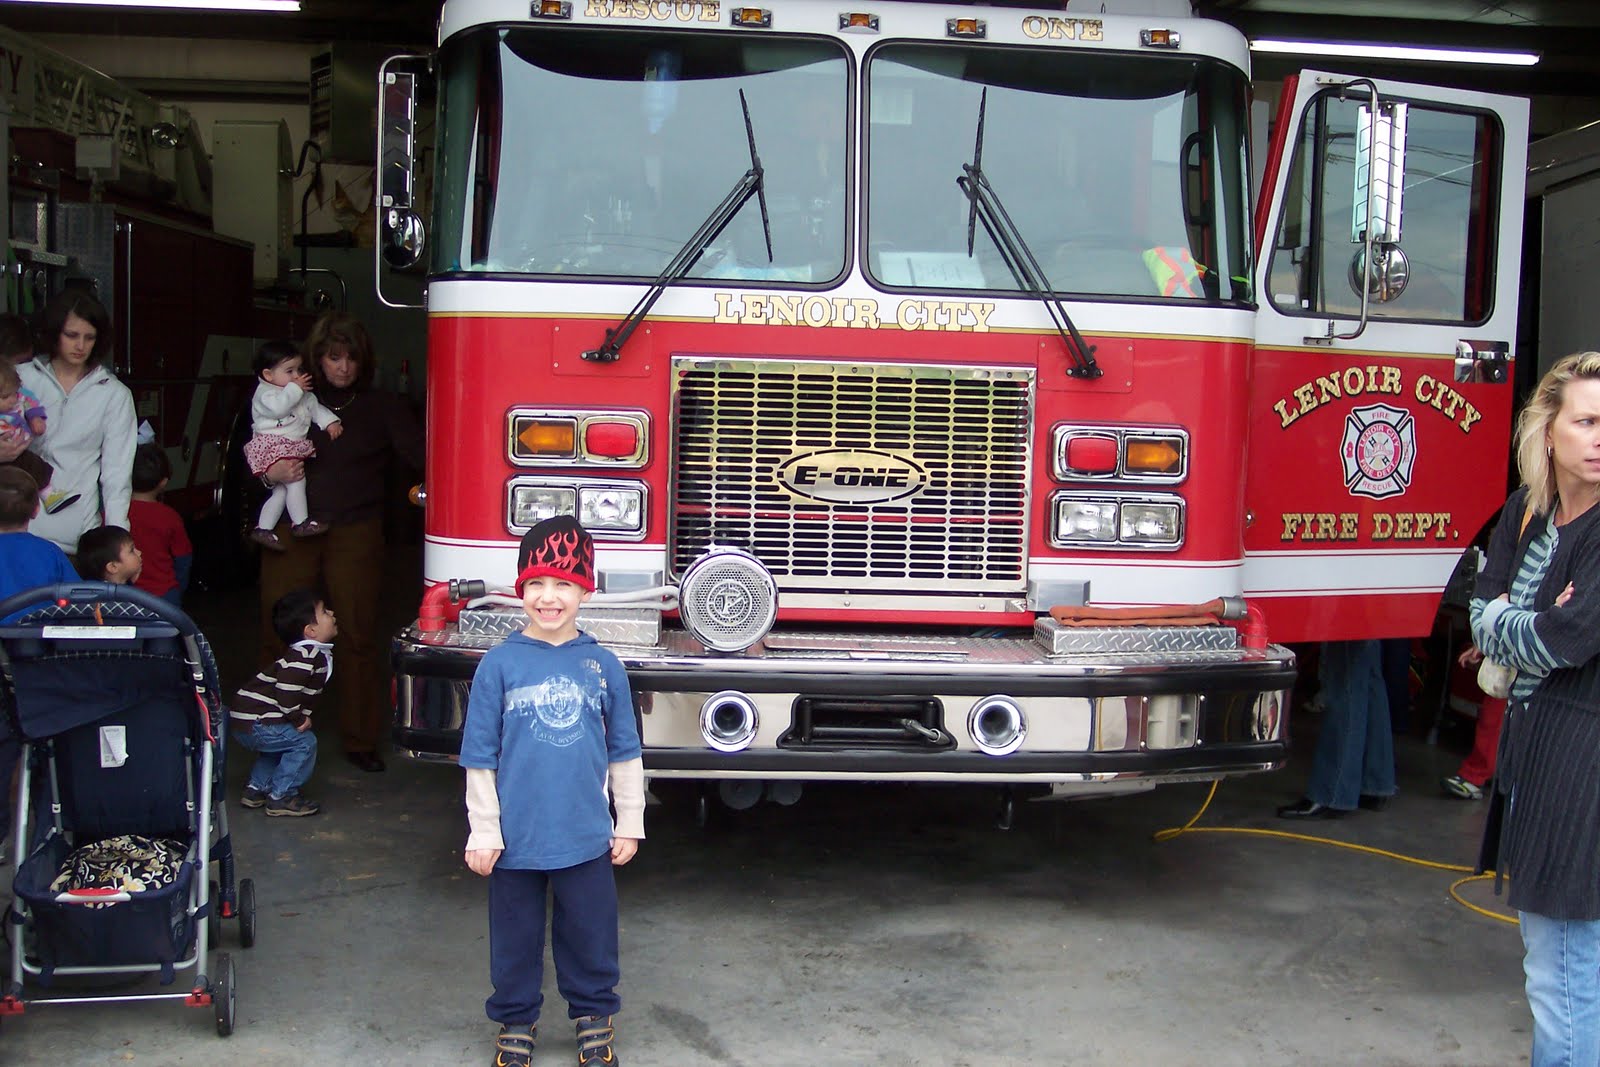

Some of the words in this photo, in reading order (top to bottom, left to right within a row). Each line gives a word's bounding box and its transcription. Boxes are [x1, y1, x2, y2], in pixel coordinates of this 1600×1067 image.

[584, 0, 720, 22] RESCUE
[1022, 15, 1103, 42] ONE
[713, 293, 881, 330] LENOIR
[896, 299, 995, 333] CITY
[1273, 365, 1402, 430] LENOIR
[1415, 374, 1482, 434] CITY
[1371, 411, 1390, 420] FIRE
[1359, 424, 1384, 448] LENOIR
[1386, 427, 1400, 447] CITY
[794, 466, 910, 487] E-ONE
[1361, 480, 1393, 491] RESCUE
[1281, 512, 1359, 541] FIRE
[1371, 512, 1459, 541] DEPT.
